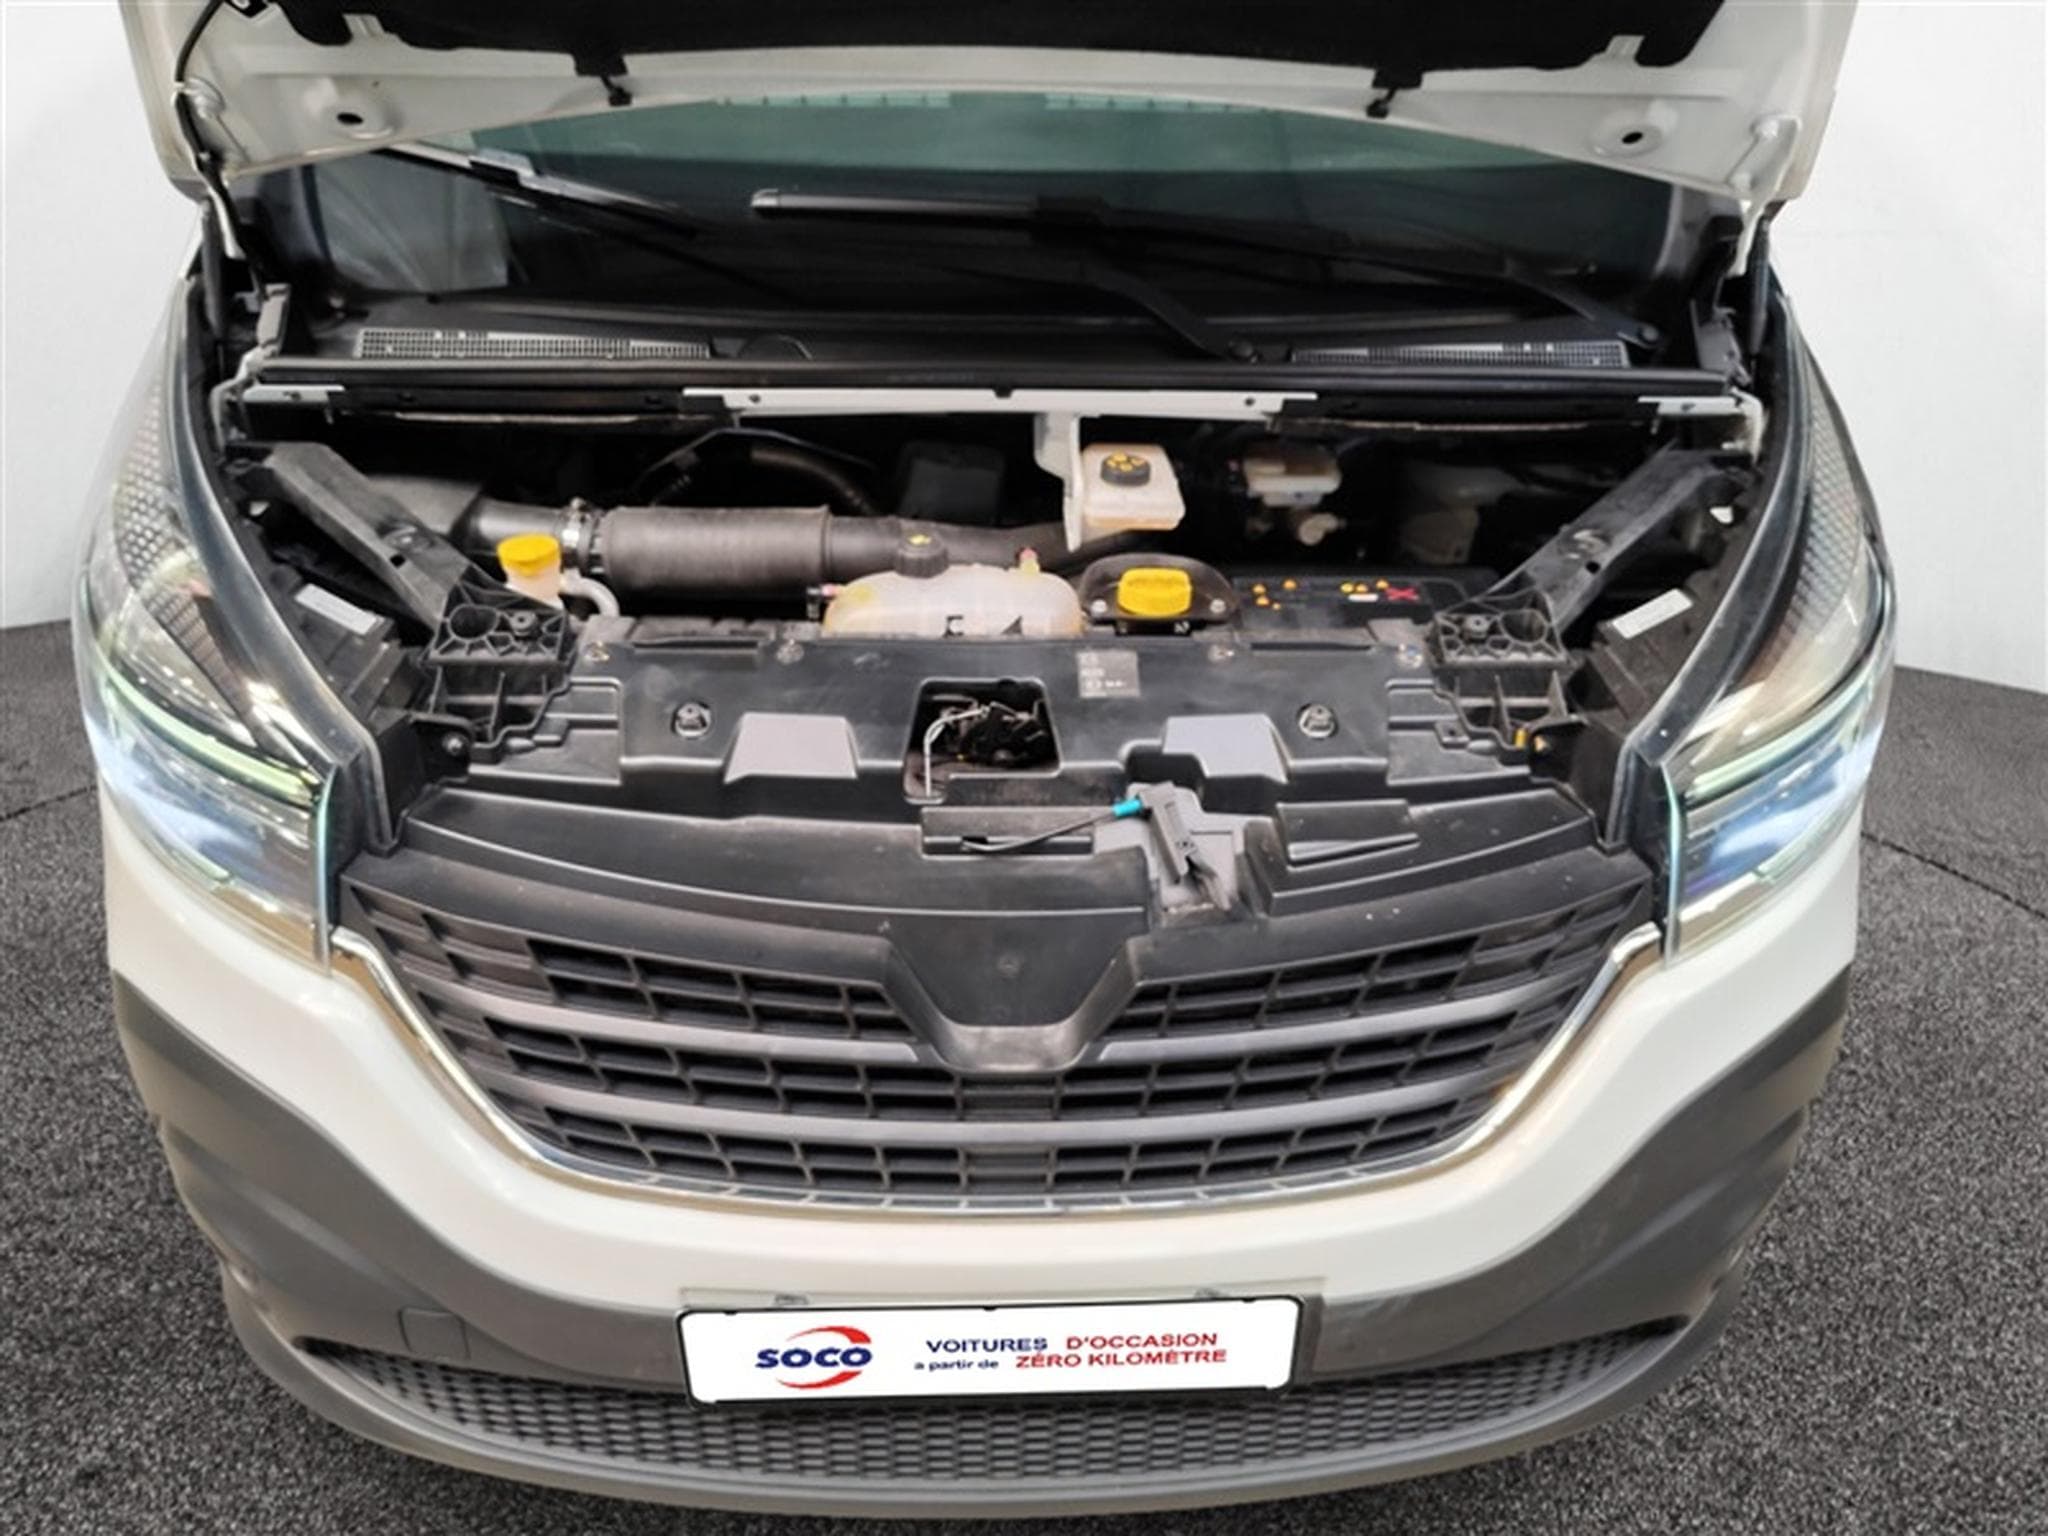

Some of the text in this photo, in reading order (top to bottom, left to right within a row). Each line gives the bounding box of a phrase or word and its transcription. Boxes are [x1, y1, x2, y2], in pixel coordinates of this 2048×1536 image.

[925, 1332, 1218, 1353] VOITURES D'OCCASION
[755, 1346, 873, 1369] SOCO
[929, 1359, 974, 1372] partir
[977, 1359, 999, 1370] de
[1015, 1351, 1082, 1368] ZÉRO
